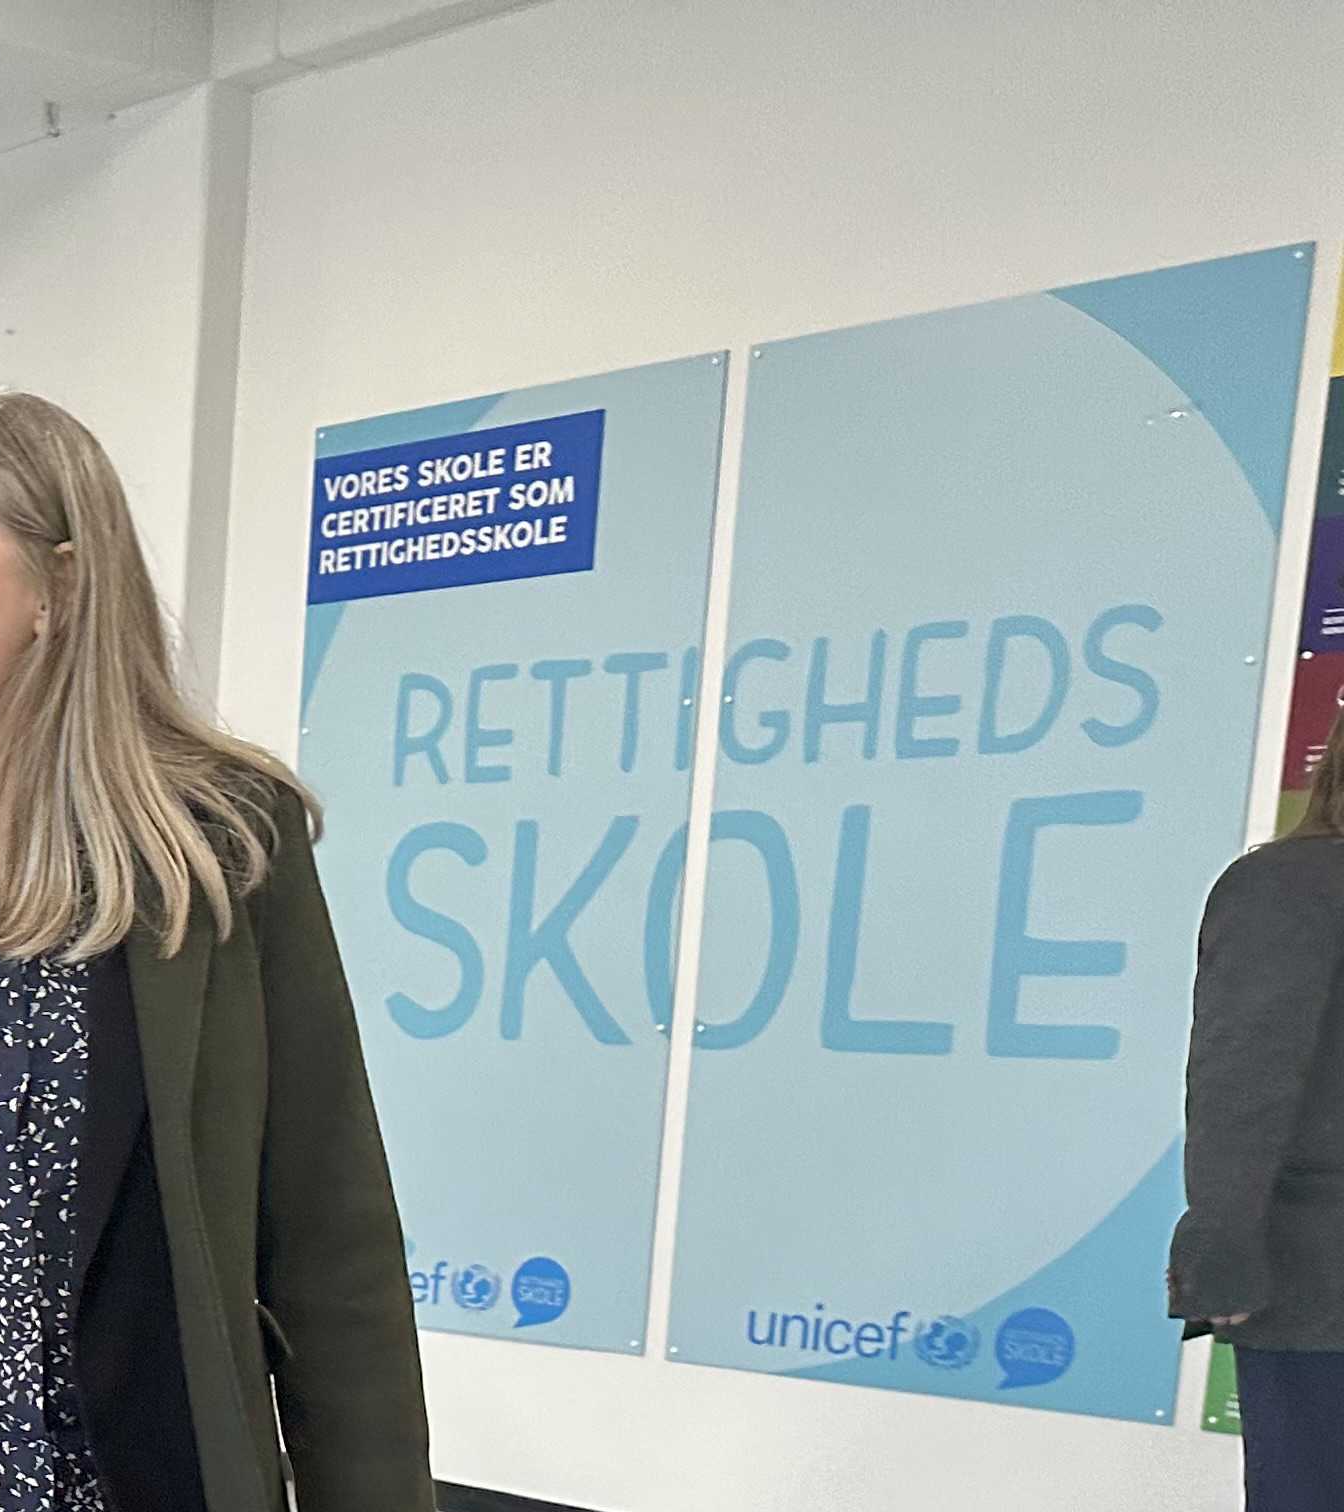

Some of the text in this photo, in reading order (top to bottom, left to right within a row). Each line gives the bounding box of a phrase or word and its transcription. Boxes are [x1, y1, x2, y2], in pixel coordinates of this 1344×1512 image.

[324, 440, 553, 502] VORES SKOLE ER
[320, 475, 575, 539] CERTIFICERET SOM
[318, 515, 568, 575] RETTIGHEDSSKOLE
[392, 603, 1165, 788] RETTIGHEDS
[385, 789, 1145, 1062] SKOLE
[746, 1302, 912, 1361] unicef
